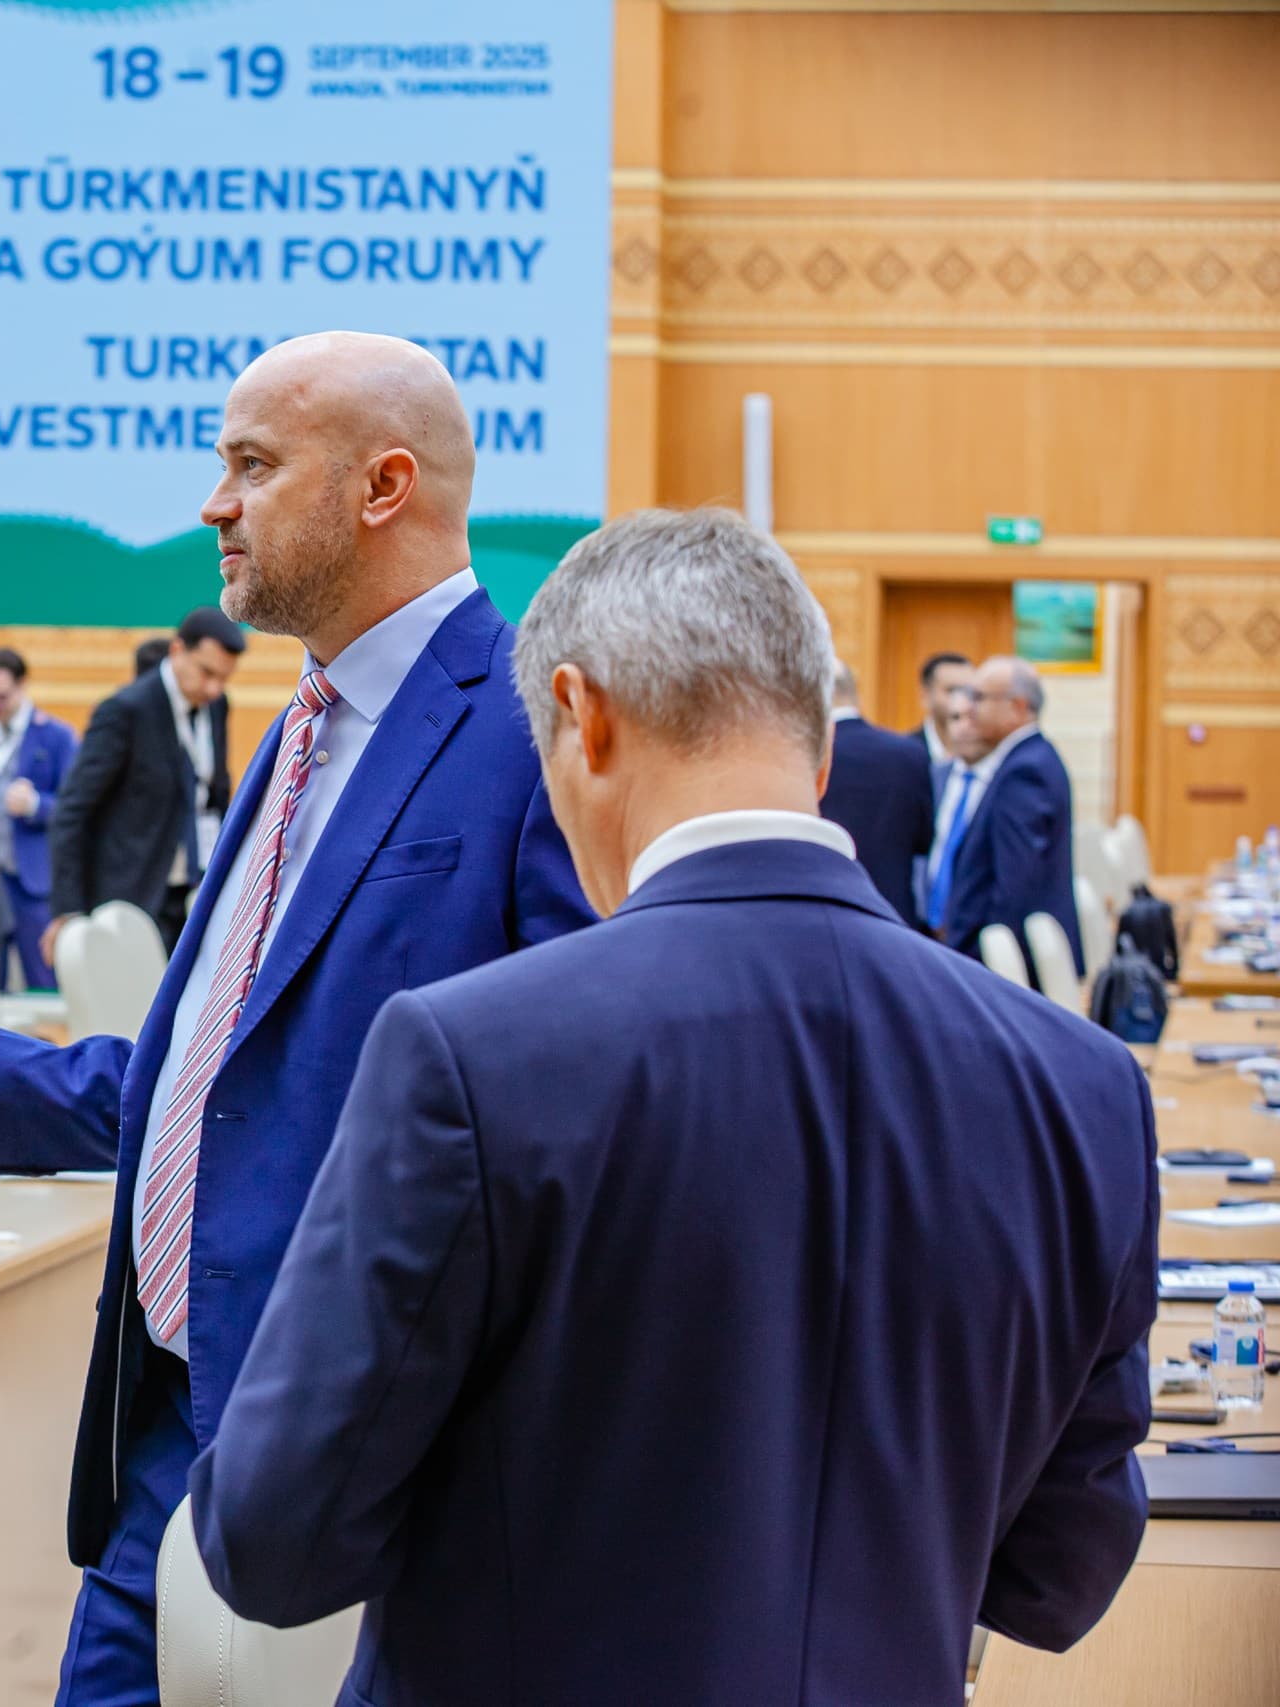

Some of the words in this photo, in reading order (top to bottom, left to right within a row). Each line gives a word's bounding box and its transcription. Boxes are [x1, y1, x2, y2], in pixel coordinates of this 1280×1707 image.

[93, 44, 163, 101] 18
[217, 43, 287, 101] 19
[307, 42, 474, 72] SEPTEMBER
[480, 42, 551, 71] 2025
[282, 238, 544, 282] FORUMY
[85, 336, 545, 381] TURKTAN
